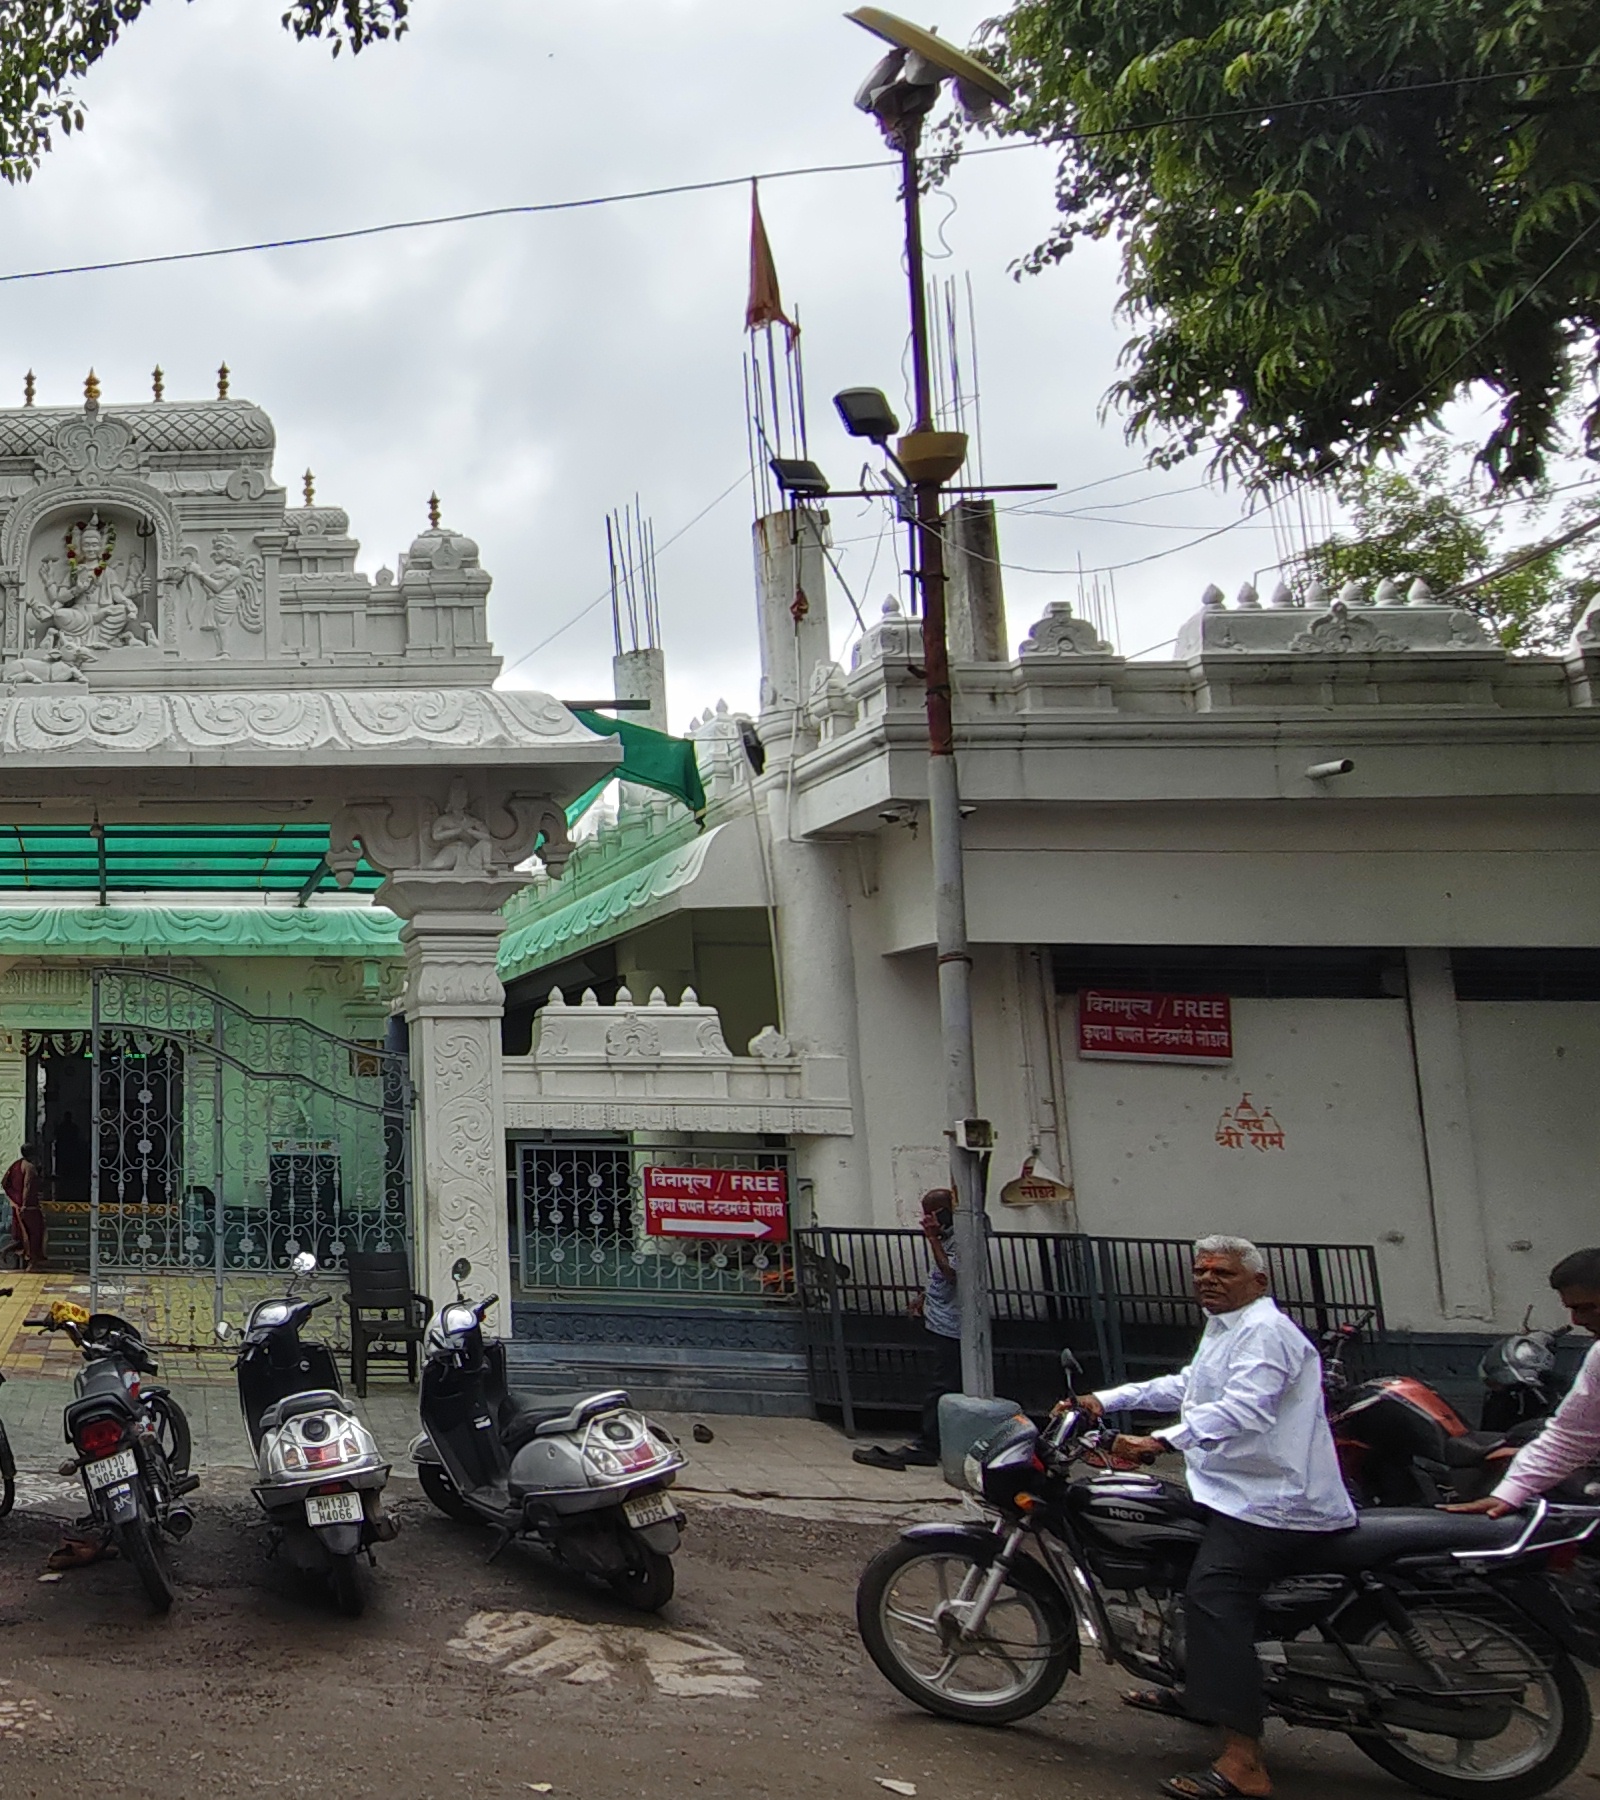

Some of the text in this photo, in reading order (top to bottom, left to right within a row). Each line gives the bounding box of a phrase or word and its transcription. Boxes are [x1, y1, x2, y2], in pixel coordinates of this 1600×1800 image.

[1086, 991, 1152, 1021] विनामूल्य
[1173, 1000, 1225, 1019] FREE
[1082, 1024, 1112, 1047] कृपया
[1114, 1025, 1144, 1043] चप्पल
[1195, 1024, 1229, 1047] सोडावे
[1234, 1118, 1265, 1132] जय
[1215, 1126, 1286, 1153] श्री राम
[650, 1167, 712, 1195] विनामूल्य
[730, 1175, 780, 1192] FREE
[1019, 1181, 1057, 1198] सोडावे
[648, 1197, 676, 1218] कृपया
[678, 1198, 705, 1214] चप्पल
[752, 1195, 784, 1217] सोडावे
[316, 1496, 350, 1511] MH13D
[319, 1508, 353, 1523] H4066
[636, 1505, 668, 1525] U3354
[1109, 1507, 1145, 1522] Hero
